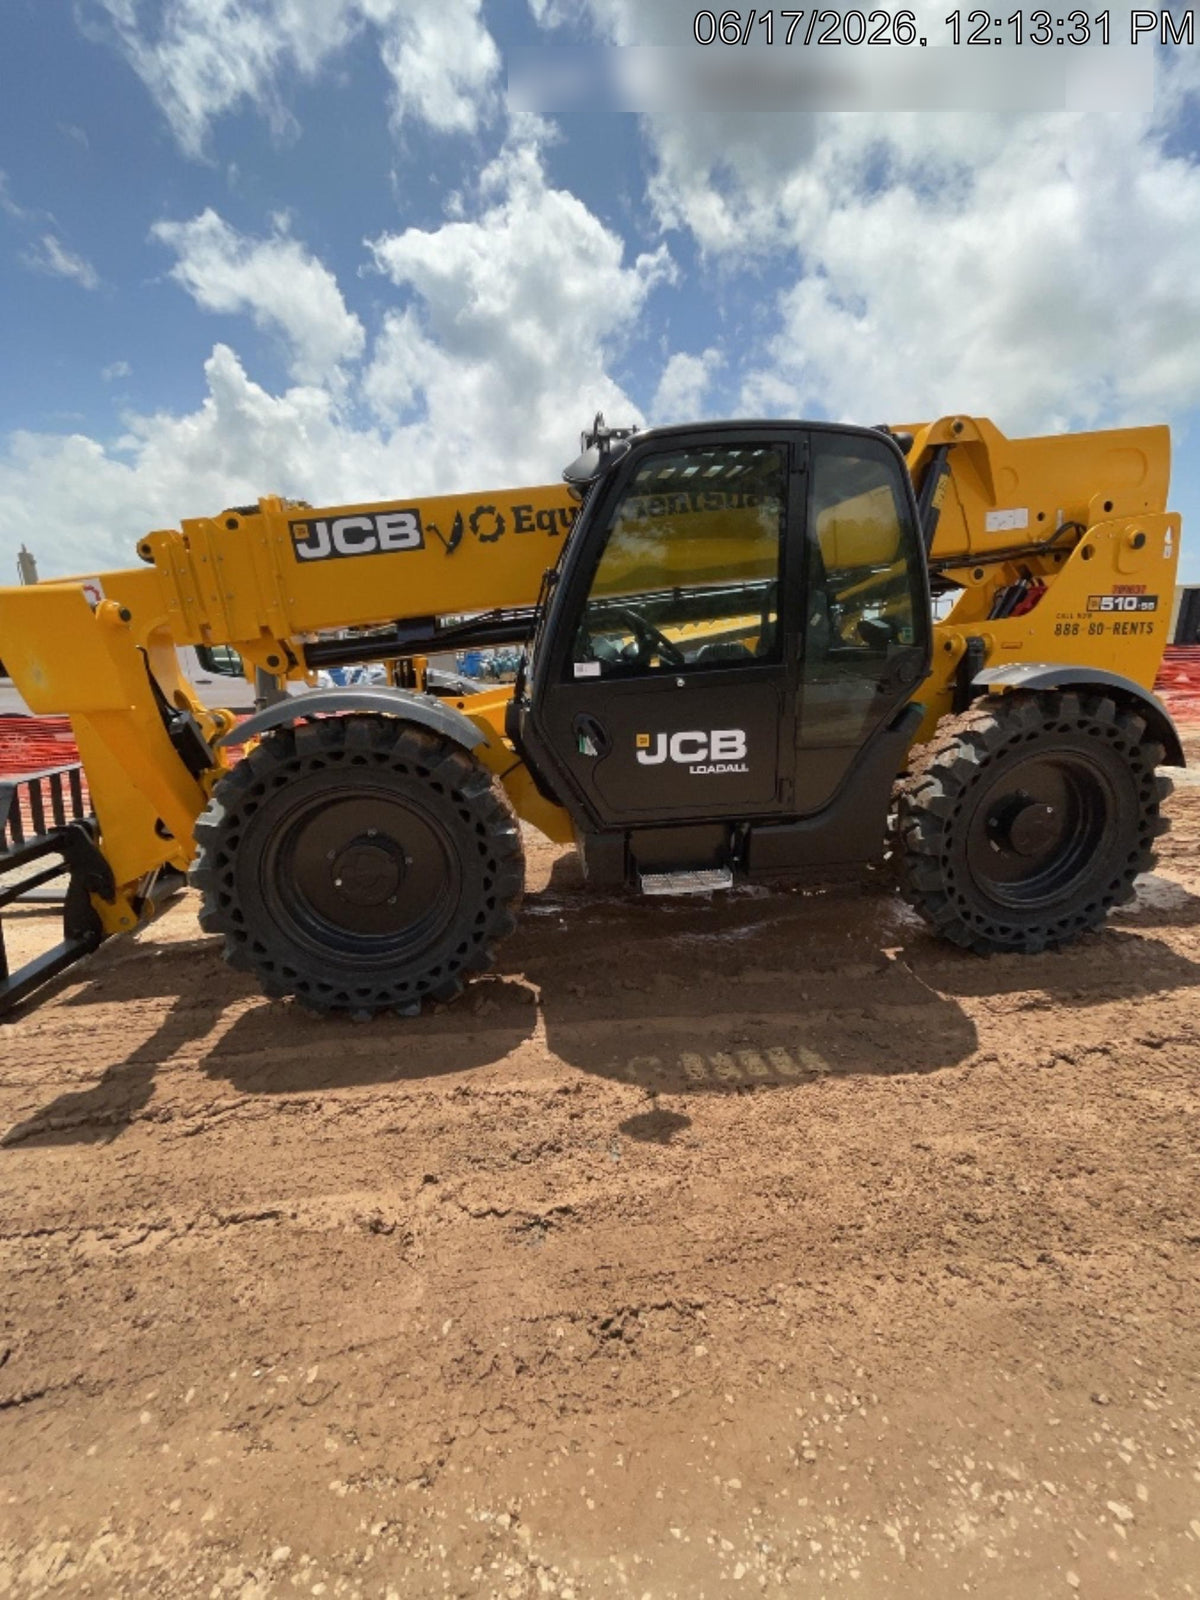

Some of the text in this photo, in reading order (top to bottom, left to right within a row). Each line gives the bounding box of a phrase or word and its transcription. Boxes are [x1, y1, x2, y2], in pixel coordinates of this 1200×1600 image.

[295, 512, 421, 560] JCB
[636, 729, 748, 765] JCB
[689, 763, 749, 775] LOADALL
